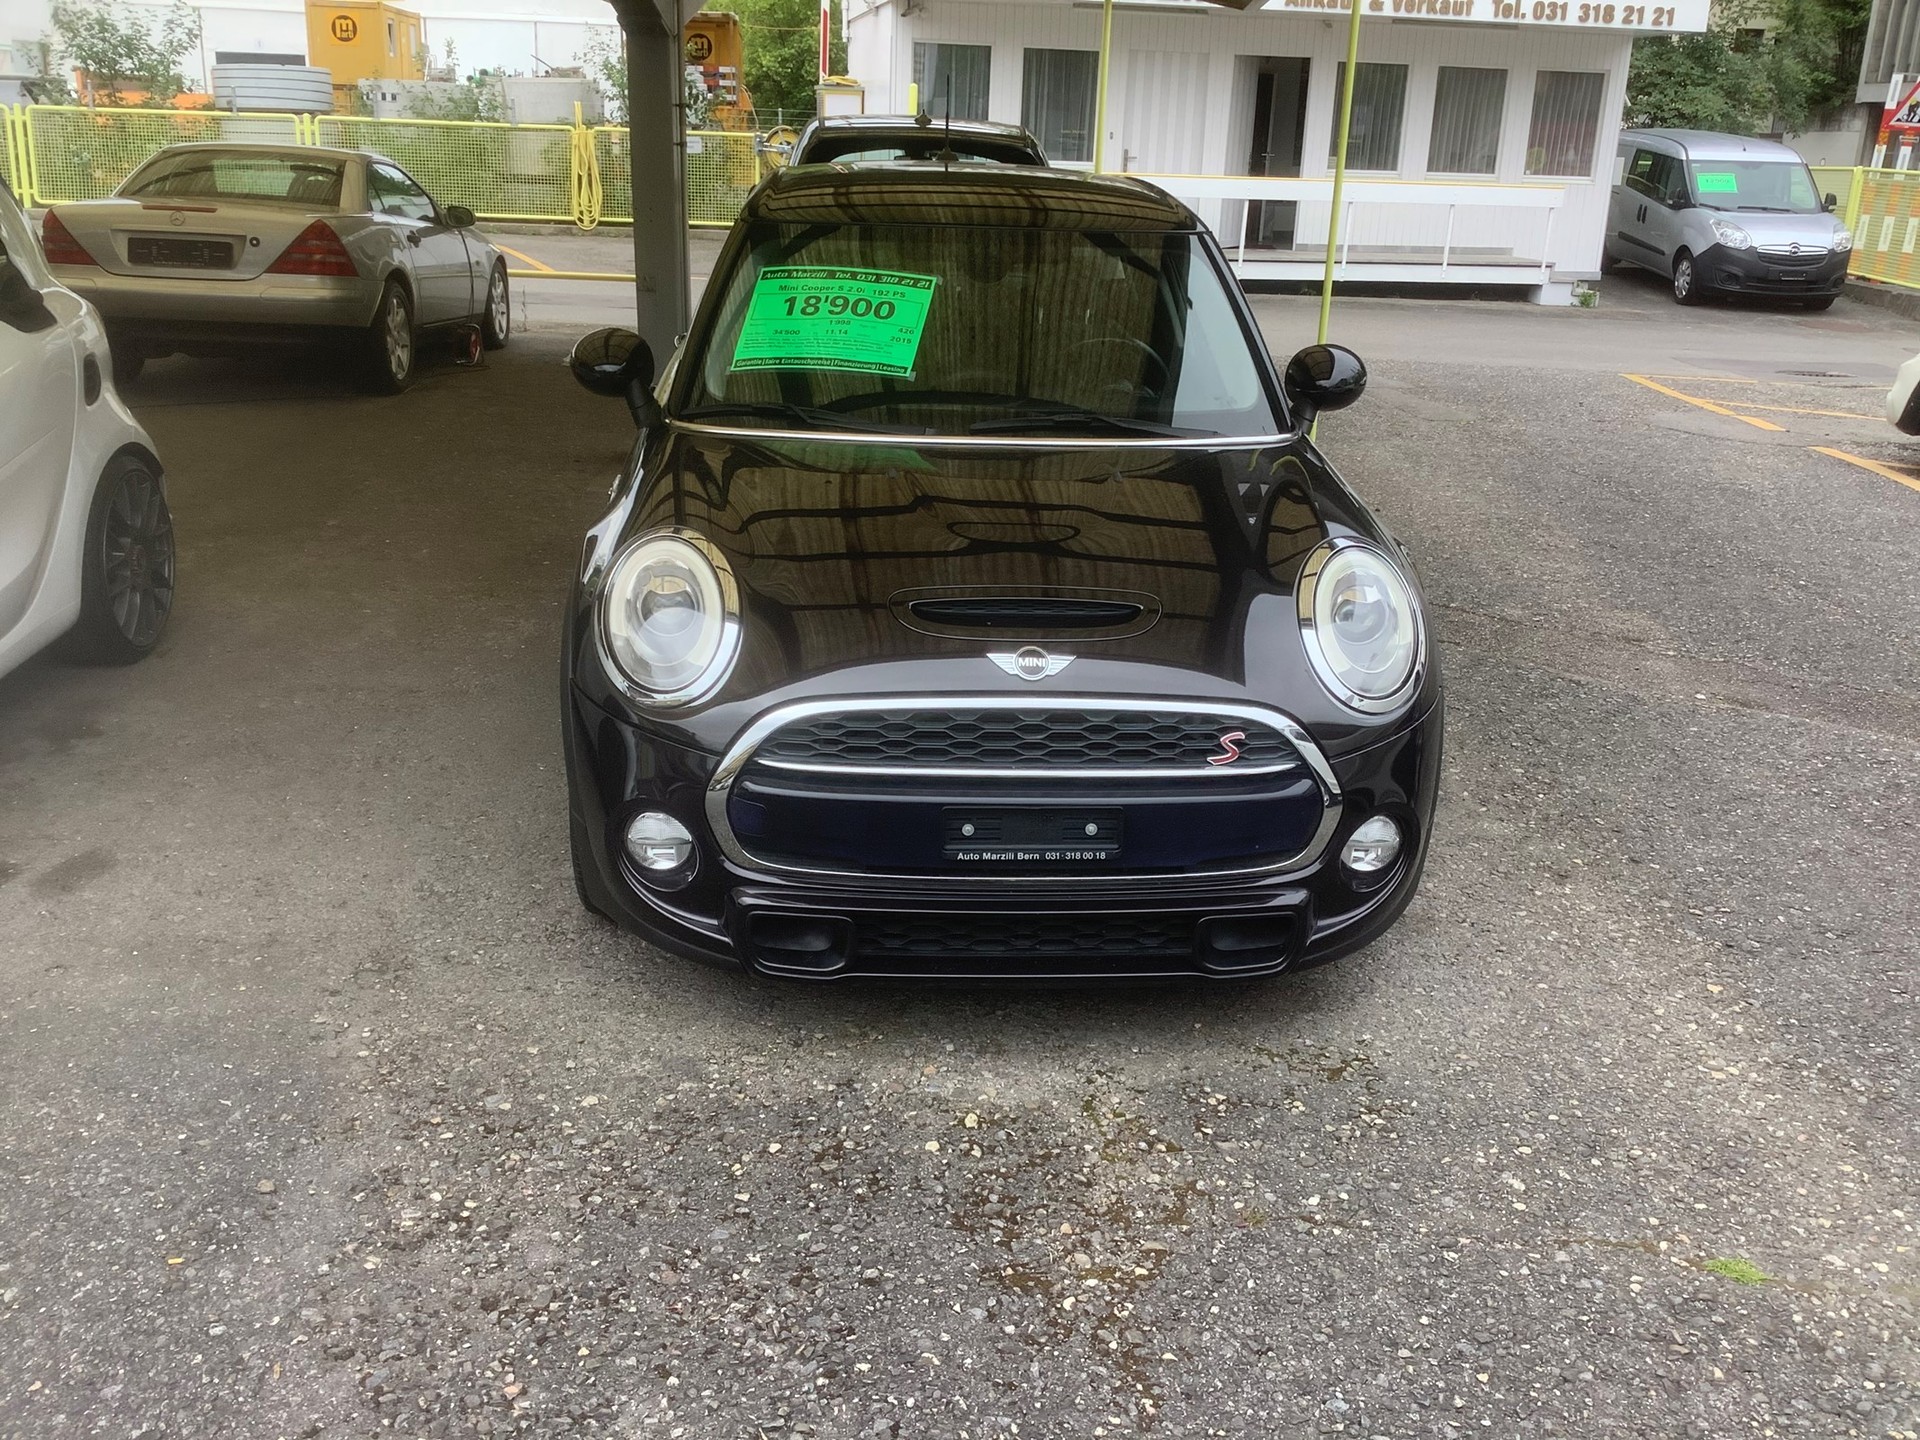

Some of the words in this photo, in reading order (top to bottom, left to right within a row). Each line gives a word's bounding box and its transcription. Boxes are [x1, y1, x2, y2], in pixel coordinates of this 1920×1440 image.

[1492, 0, 1526, 19] Tel.
[1532, 1, 1568, 21] 031
[1578, 3, 1615, 24] 318
[1621, 5, 1645, 25] 21
[1651, 7, 1676, 26] 21
[763, 271, 788, 279] Auto
[790, 271, 827, 279] Marzili
[835, 272, 852, 280] Tel.
[857, 274, 876, 282] 031
[879, 275, 899, 284] 318
[901, 277, 914, 286] 21
[917, 279, 930, 288] 21
[778, 284, 798, 292] Mini
[801, 284, 835, 294] Cooper
[847, 286, 866, 294] 2.0i
[872, 289, 889, 297] 192
[892, 290, 906, 299] PS
[783, 294, 896, 320] 18'900
[889, 336, 912, 344] 2015
[1018, 657, 1046, 667] MINI
[1206, 731, 1246, 766] S
[957, 852, 980, 860] Auto
[982, 852, 1015, 860] Marzili
[1017, 852, 1040, 860] Bern
[1083, 852, 1094, 860] 00
[1095, 852, 1106, 860] 18
